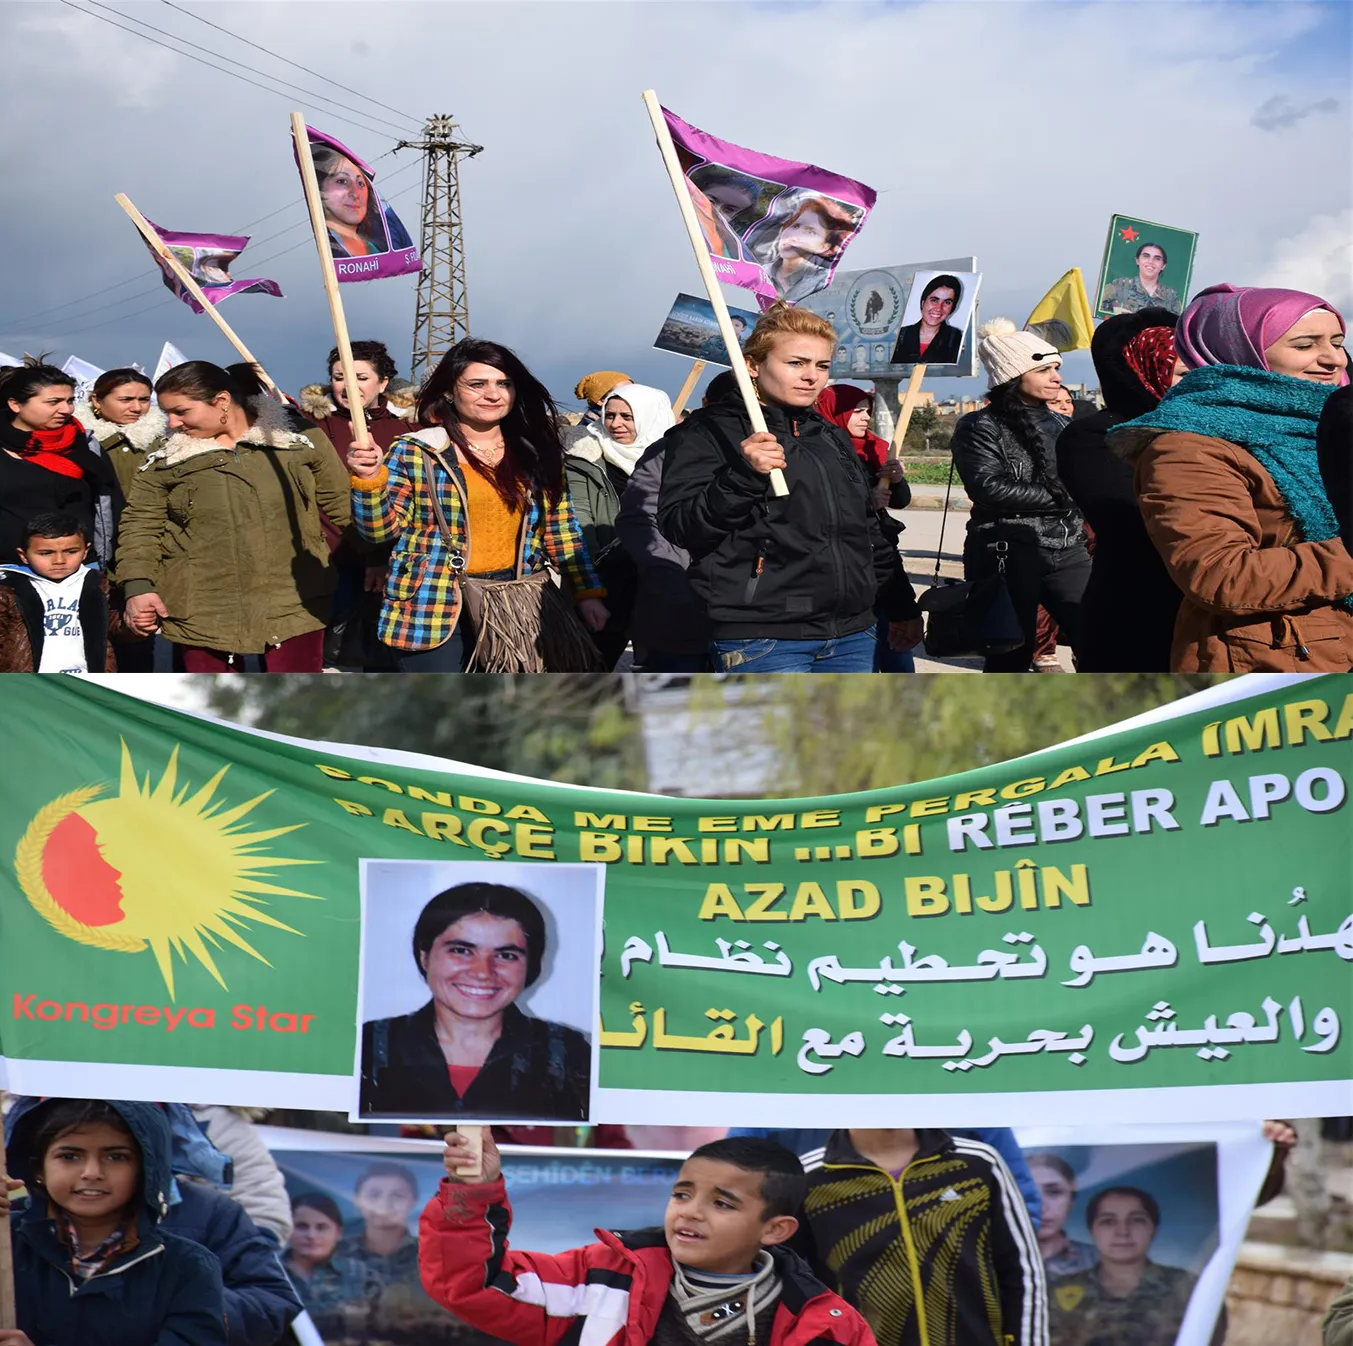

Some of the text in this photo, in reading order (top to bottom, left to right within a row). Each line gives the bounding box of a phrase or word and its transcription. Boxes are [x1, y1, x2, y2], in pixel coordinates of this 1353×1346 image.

[338, 257, 379, 274] RONAHÎ
[314, 764, 551, 824] SONDA
[574, 810, 674, 834] ME
[697, 808, 840, 834] EMÊ
[864, 741, 1179, 824] PERGALA
[333, 797, 556, 860] PARÇE
[579, 830, 770, 864] BIKIN
[947, 787, 1177, 850] RÊBER
[1200, 767, 1345, 825] APO
[698, 859, 1091, 921] AZAD BIJÎN
[620, 930, 793, 978] نظام
[807, 930, 1047, 995] تحطيم
[1059, 930, 1179, 987] هو
[11, 993, 316, 1034] Kongreya Star
[600, 995, 1341, 1074] والعيش بحرية مع القائ
